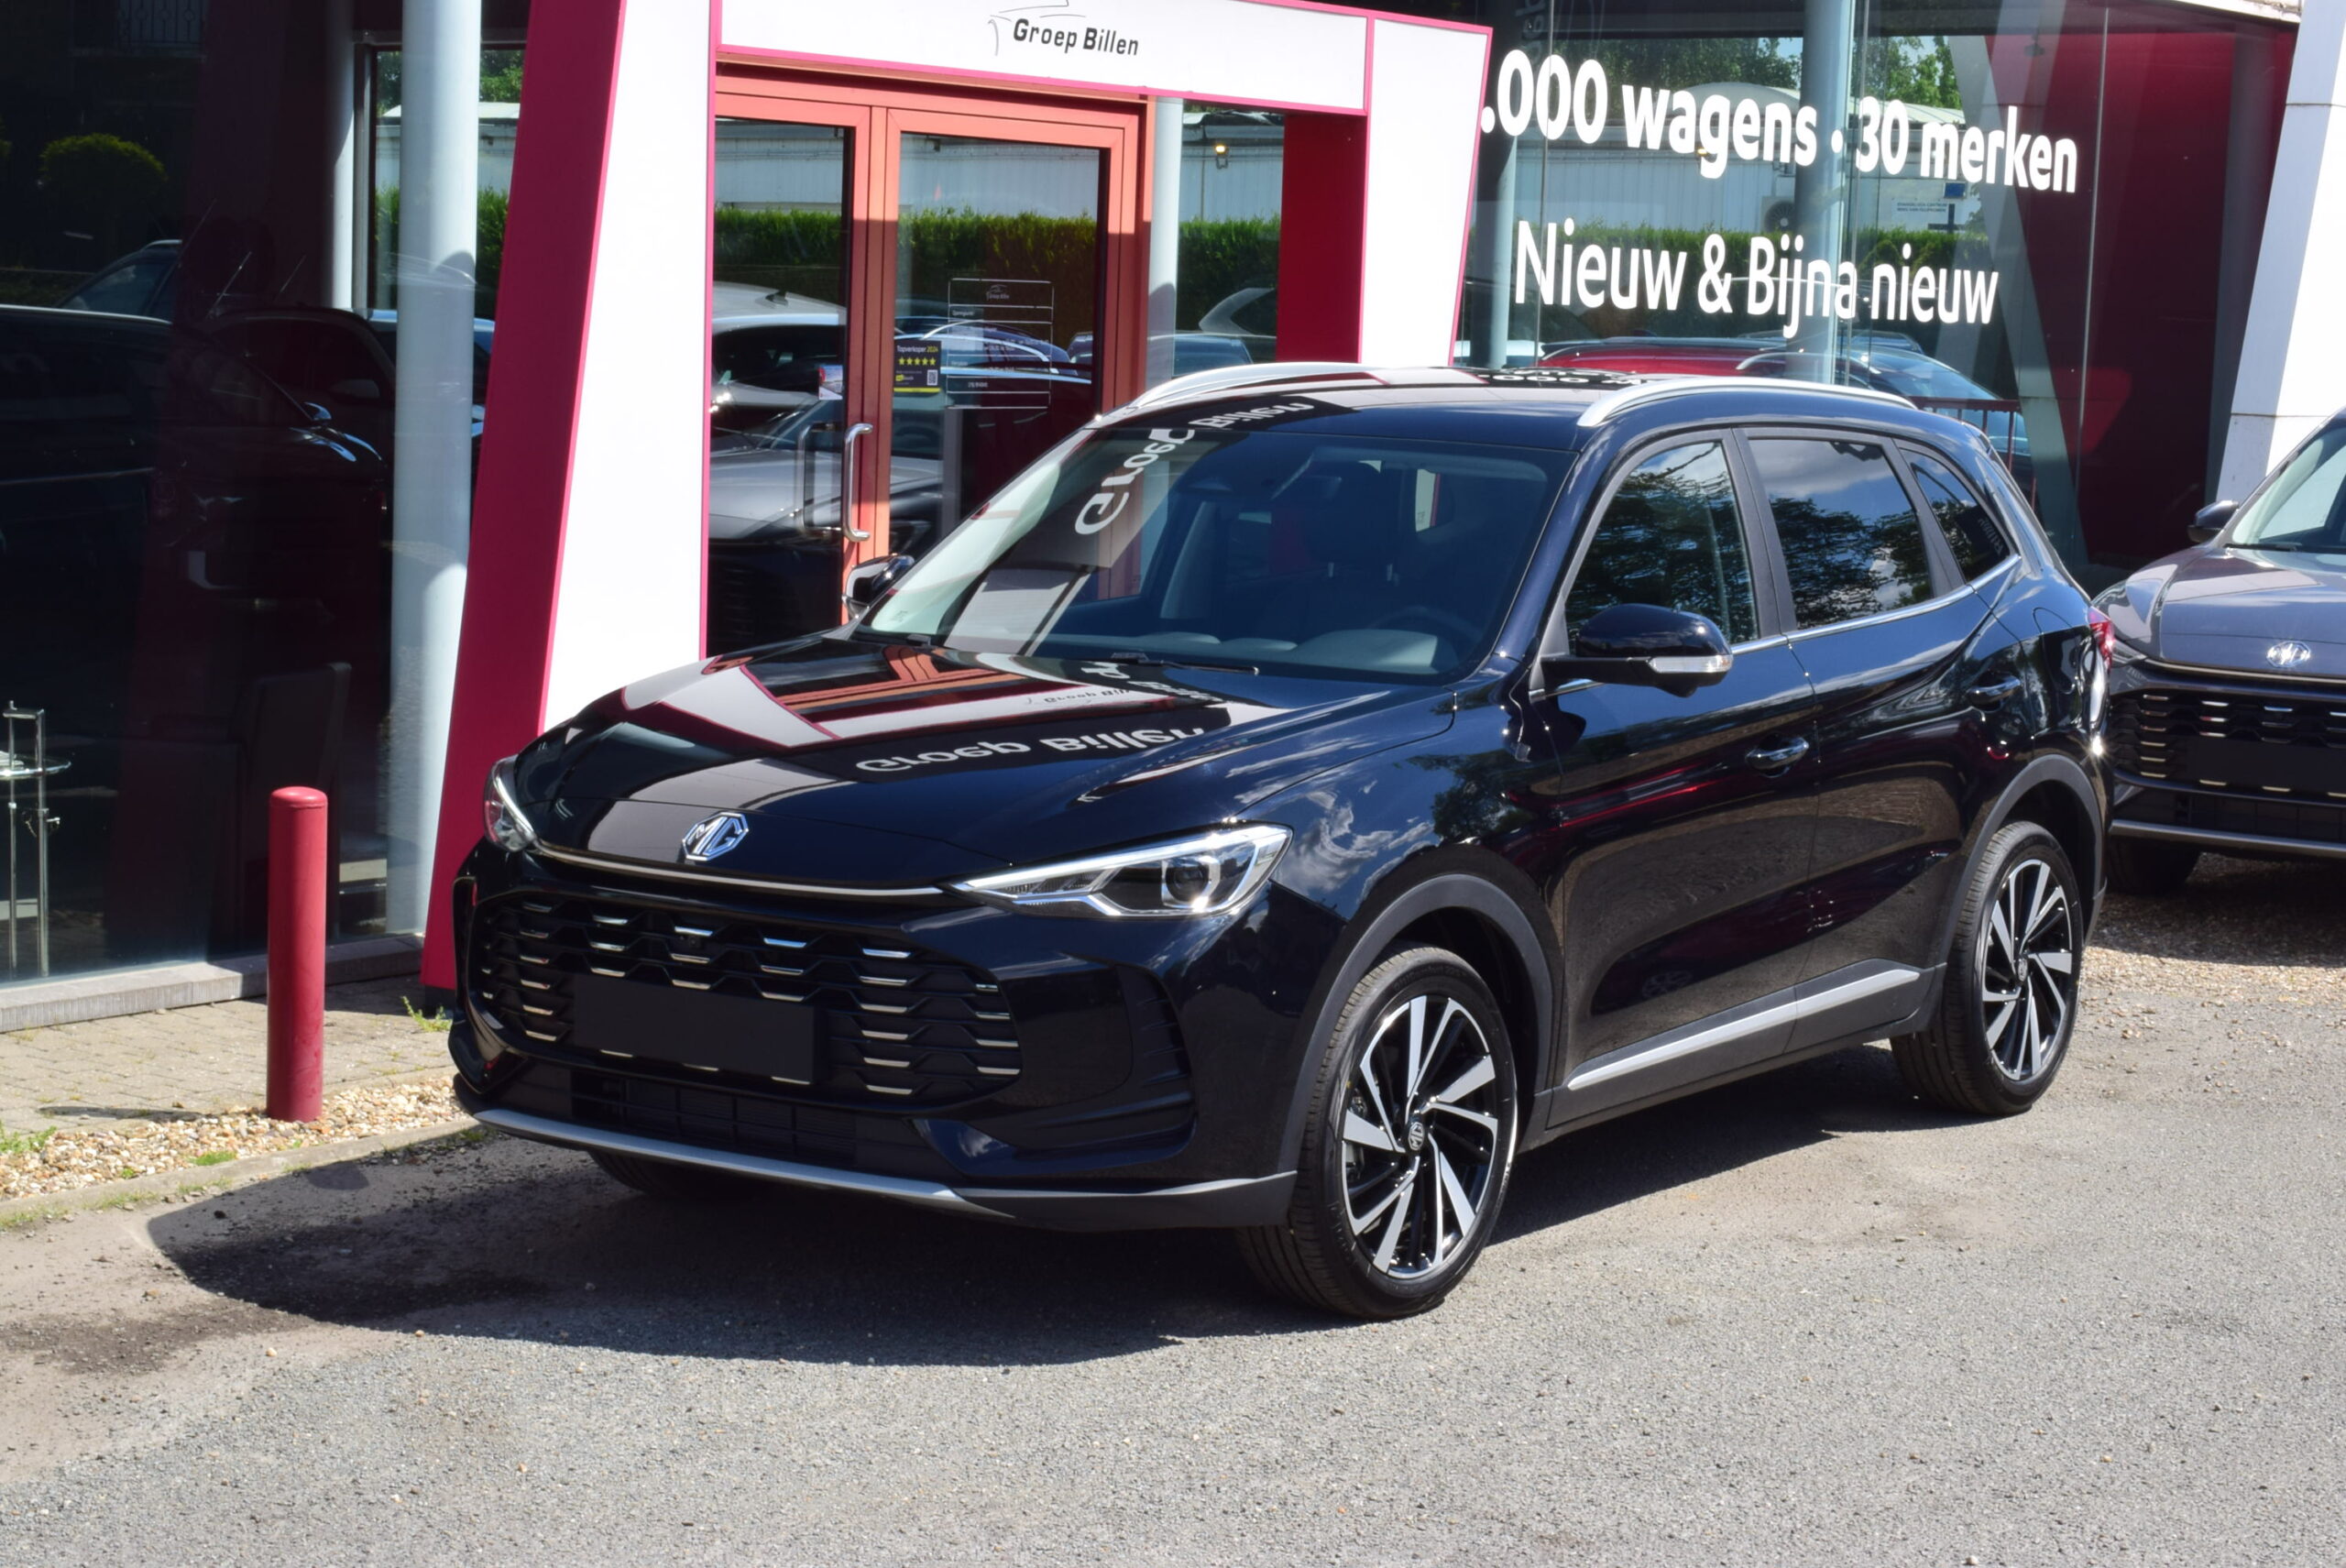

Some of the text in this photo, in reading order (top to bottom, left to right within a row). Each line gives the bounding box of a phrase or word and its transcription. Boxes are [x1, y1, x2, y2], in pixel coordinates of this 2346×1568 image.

[1014, 18, 1139, 56] Groep Billen
[1621, 84, 1817, 180] wagens
[1855, 95, 1910, 176] 30
[1920, 105, 2077, 193] merken
[1515, 217, 1999, 339] Nieuw & Bijna nieuw
[683, 812, 749, 861] MG
